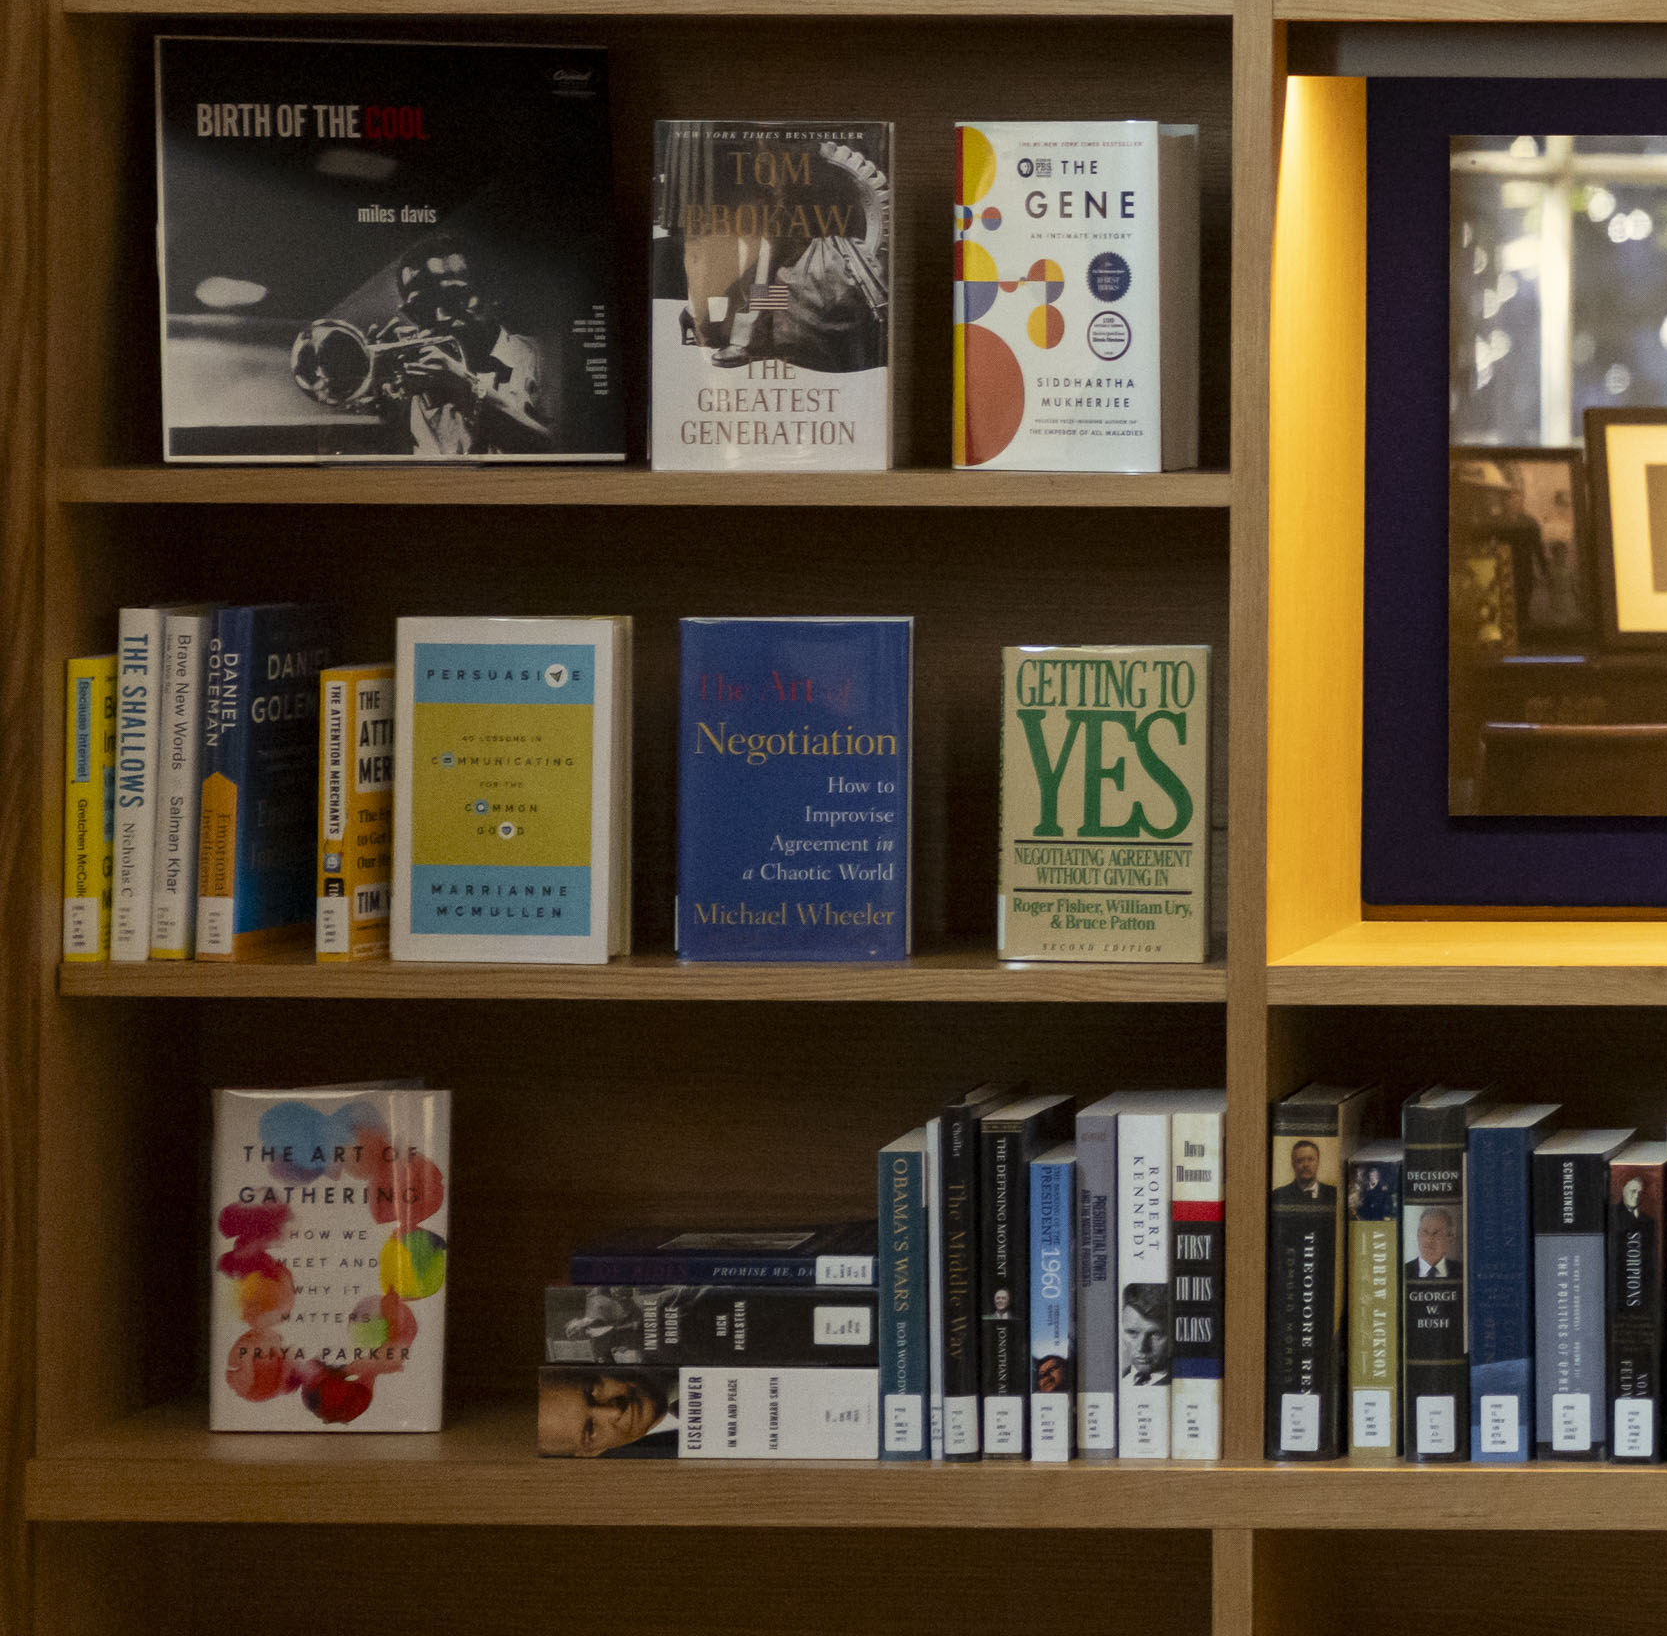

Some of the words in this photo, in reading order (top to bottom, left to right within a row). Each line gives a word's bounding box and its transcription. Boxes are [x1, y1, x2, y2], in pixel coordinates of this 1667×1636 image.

[197, 103, 270, 137] BIRTH
[277, 104, 306, 137] OF
[313, 105, 360, 138] THE
[358, 205, 395, 223] miles
[400, 205, 436, 223] davis
[1025, 191, 1135, 219] GENE
[1037, 377, 1135, 389] SIDDHARTHA
[697, 389, 839, 413] GREATEST
[1041, 396, 1130, 408] MUKHERJEE
[681, 421, 855, 445] GENERATION
[123, 634, 148, 676] THE
[1016, 660, 1146, 709] GETTING
[1153, 662, 1195, 708] TO
[120, 686, 146, 809] SHALLOWS
[695, 722, 897, 764] Negotiation
[1016, 709, 1194, 839] YES
[805, 806, 894, 826] Improvise
[693, 903, 786, 926] Michael
[796, 903, 894, 925] Wheeler
[1407, 1172, 1458, 1180] DECISION
[1413, 1182, 1452, 1192] POINTS
[239, 1187, 419, 1205] GATHERING
[1177, 1235, 1211, 1260] FIRST
[1176, 1277, 1191, 1301] IN
[1193, 1276, 1212, 1301] HIS
[1409, 1291, 1457, 1302] GEORGE
[1176, 1318, 1212, 1342] CLASS
[1417, 1318, 1449, 1328] BUSH
